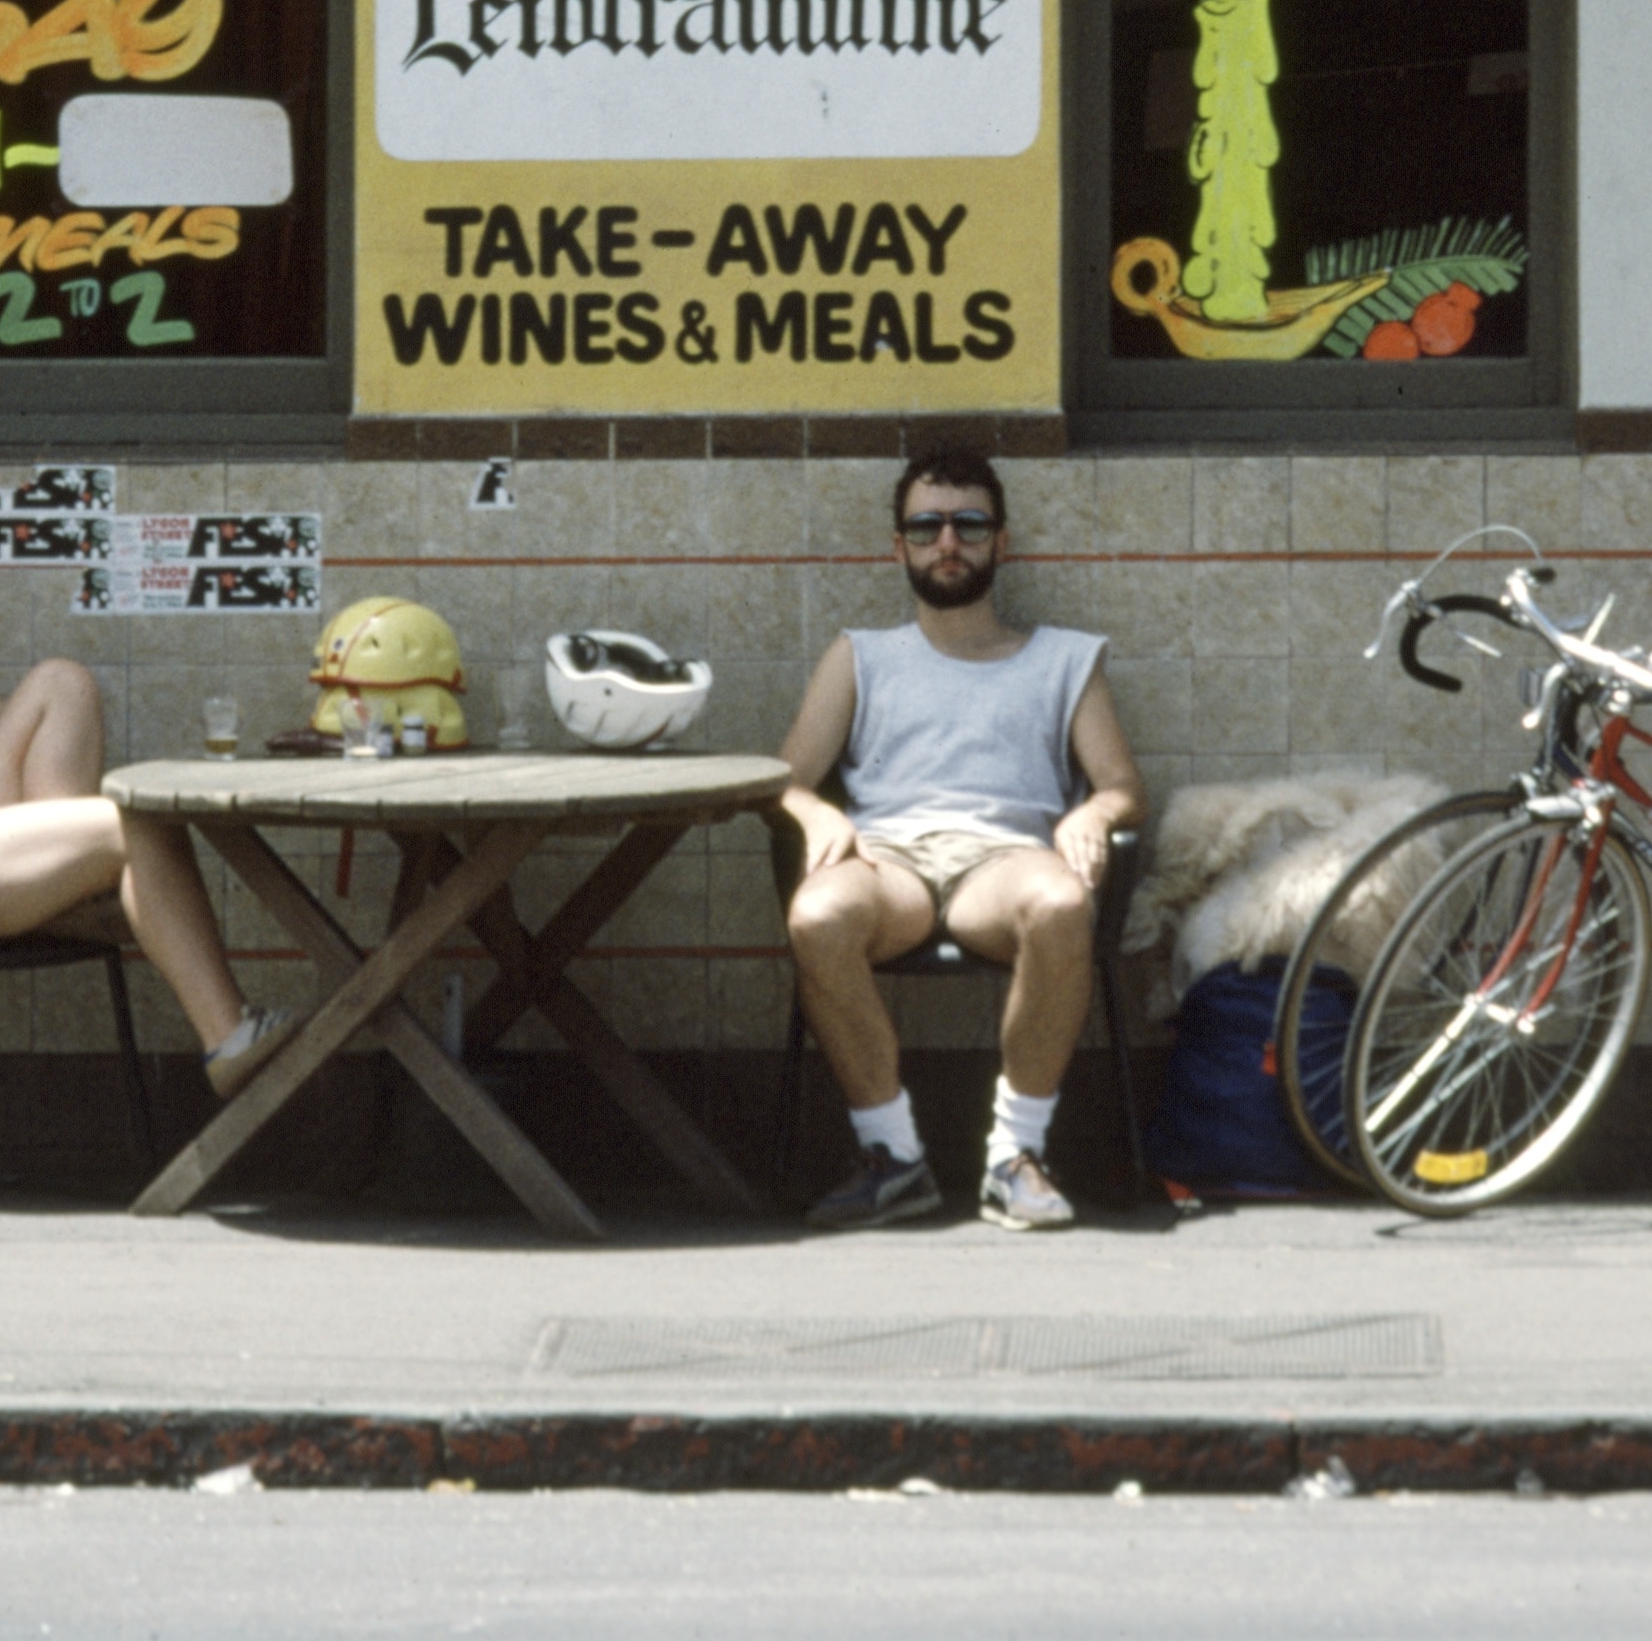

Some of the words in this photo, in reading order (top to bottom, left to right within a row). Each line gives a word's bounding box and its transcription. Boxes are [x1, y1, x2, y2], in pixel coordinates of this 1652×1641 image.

[423, 203, 969, 278] TAKE-AWAY
[61, 279, 99, 316] TO
[111, 270, 195, 346] 2
[383, 291, 665, 365] WINES
[675, 299, 719, 365] &
[735, 290, 1017, 363] MEALS
